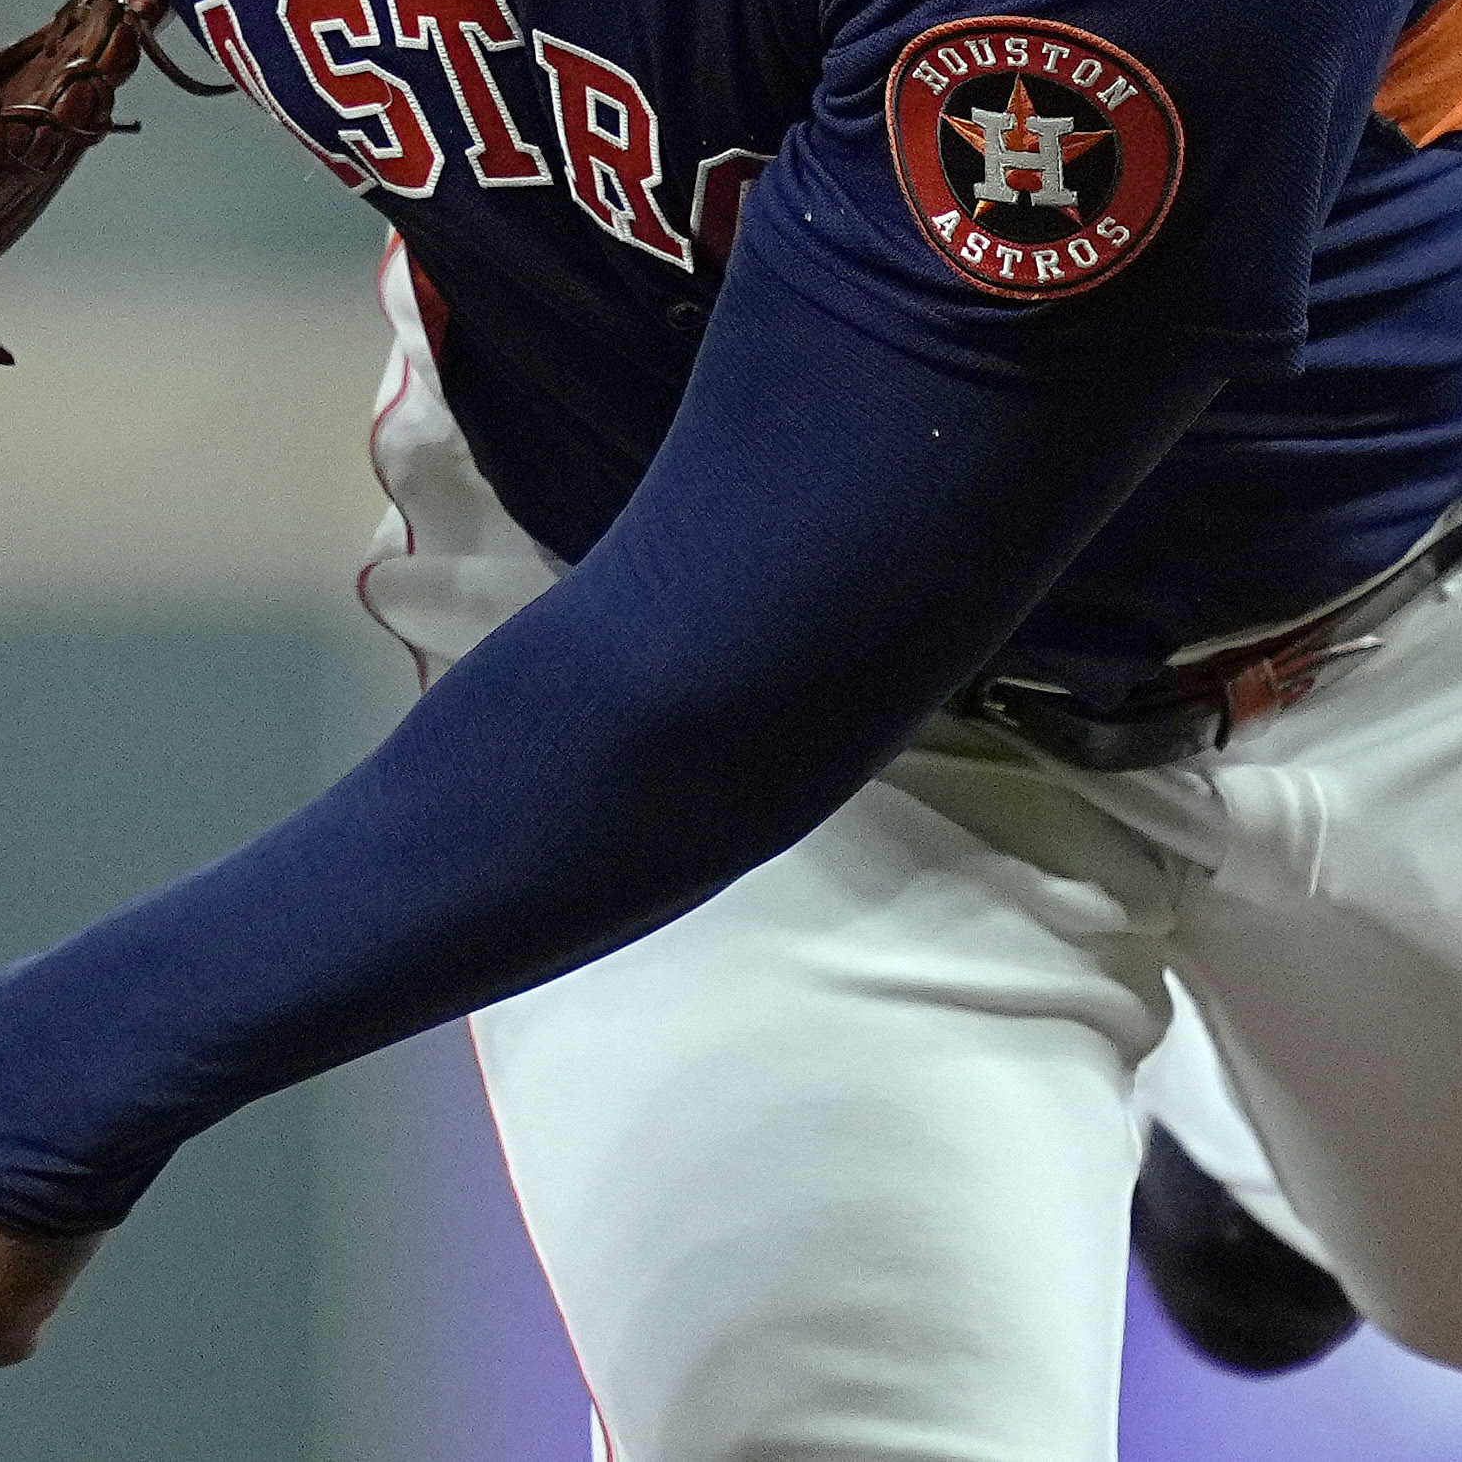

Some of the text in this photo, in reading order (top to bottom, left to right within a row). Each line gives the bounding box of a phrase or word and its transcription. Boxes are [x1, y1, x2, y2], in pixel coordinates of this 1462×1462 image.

[913, 37, 1138, 111] HOUSTON
[971, 106, 1079, 206] H
[932, 209, 1130, 283] ASTROS
